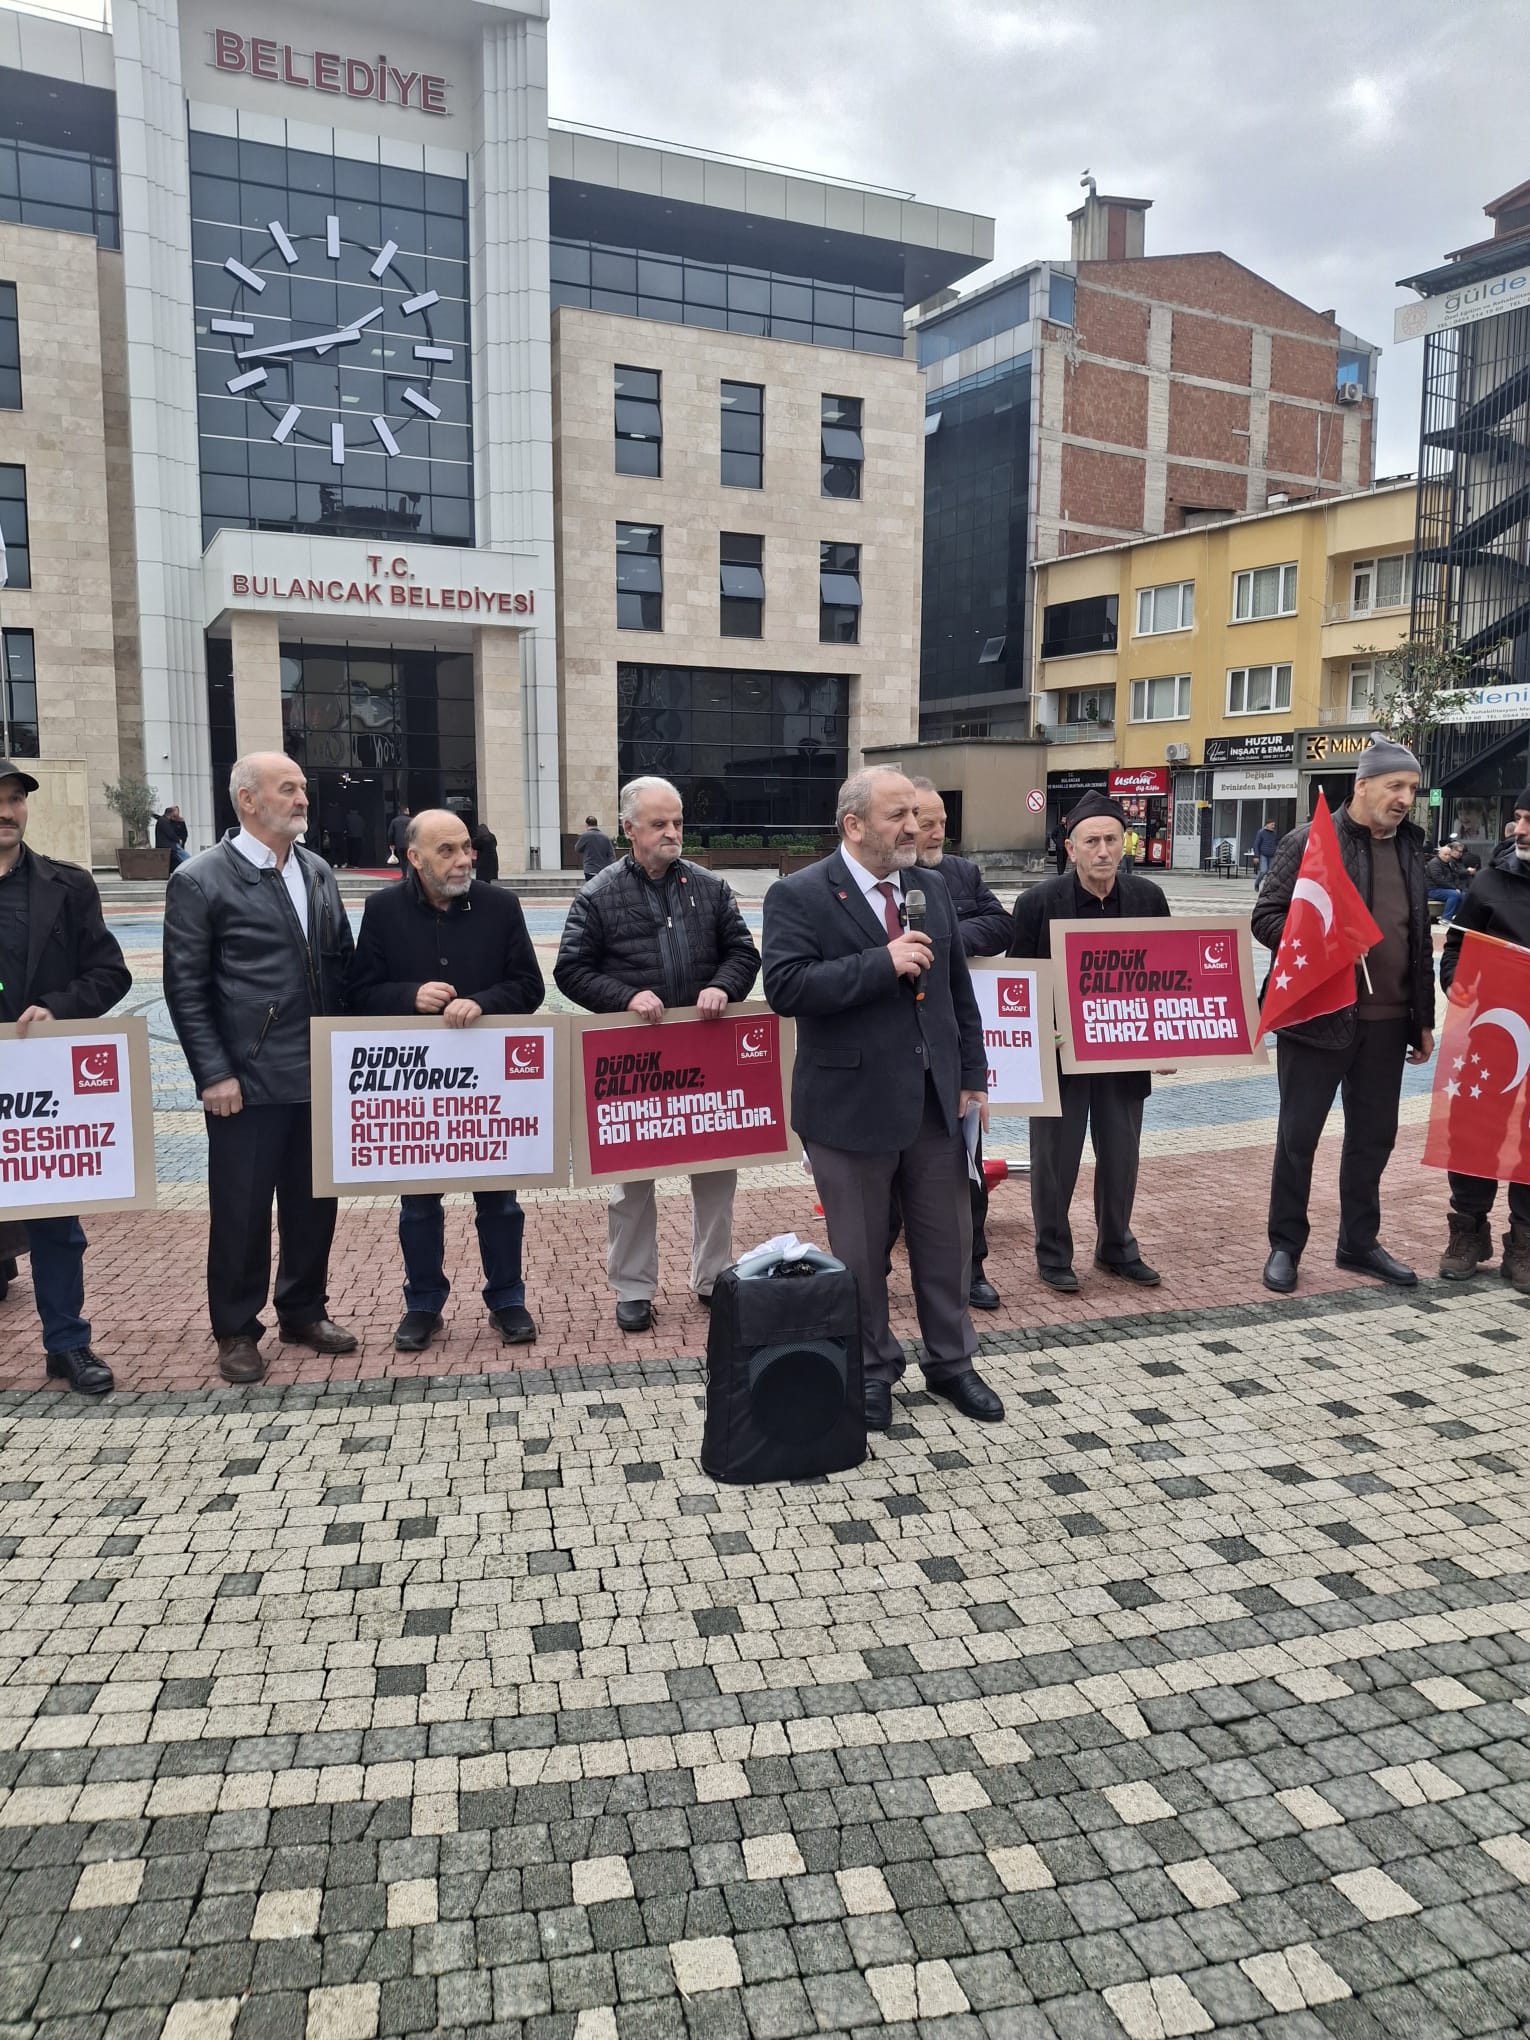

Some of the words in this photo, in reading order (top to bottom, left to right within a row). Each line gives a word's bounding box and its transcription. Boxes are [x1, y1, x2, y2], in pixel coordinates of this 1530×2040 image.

[215, 28, 448, 114] BELEDİYE
[367, 555, 415, 580] T.C.
[232, 574, 382, 605] BULANCAK
[390, 585, 536, 615] BELEDİYESİ
[1230, 747, 1259, 756] İNŞAAT
[1261, 746, 1266, 754] &
[1245, 735, 1283, 746] HUZUR
[1245, 771, 1274, 780] Değişim
[1080, 949, 1147, 971] DÜDÜK
[1079, 970, 1192, 995] ÇALIYORUZ;
[1082, 998, 1149, 1023] ÇÜNKÜ
[1154, 996, 1227, 1019] ADALET
[983, 1030, 1032, 1048] MLER
[1085, 1021, 1149, 1043] ENKAZ
[1153, 1018, 1239, 1041] ALTINDA!
[350, 1045, 429, 1069] DÜDÜK
[595, 1051, 662, 1078] DÜDÜK
[740, 1050, 768, 1059] SAADET
[78, 1078, 115, 1088] SAADET
[349, 1067, 479, 1094] ÇALIYORUZ;
[509, 1066, 540, 1074] SAADET
[594, 1067, 705, 1100] ÇALIYORUZ;
[351, 1096, 425, 1122] ÇÜNKÜ
[433, 1095, 501, 1117] ENKAZ
[597, 1097, 662, 1125] ÇÜNKÜ
[667, 1088, 745, 1116] İHMALİN
[2, 1122, 116, 1154] SESİMİZ
[351, 1120, 440, 1143] ALTINDA
[448, 1116, 539, 1140] KALMAK
[598, 1124, 631, 1145] ADI
[636, 1116, 686, 1141] KAZA
[691, 1106, 776, 1134] DEĞİLDİR.
[351, 1140, 508, 1167] İSTEMİYORUZ!
